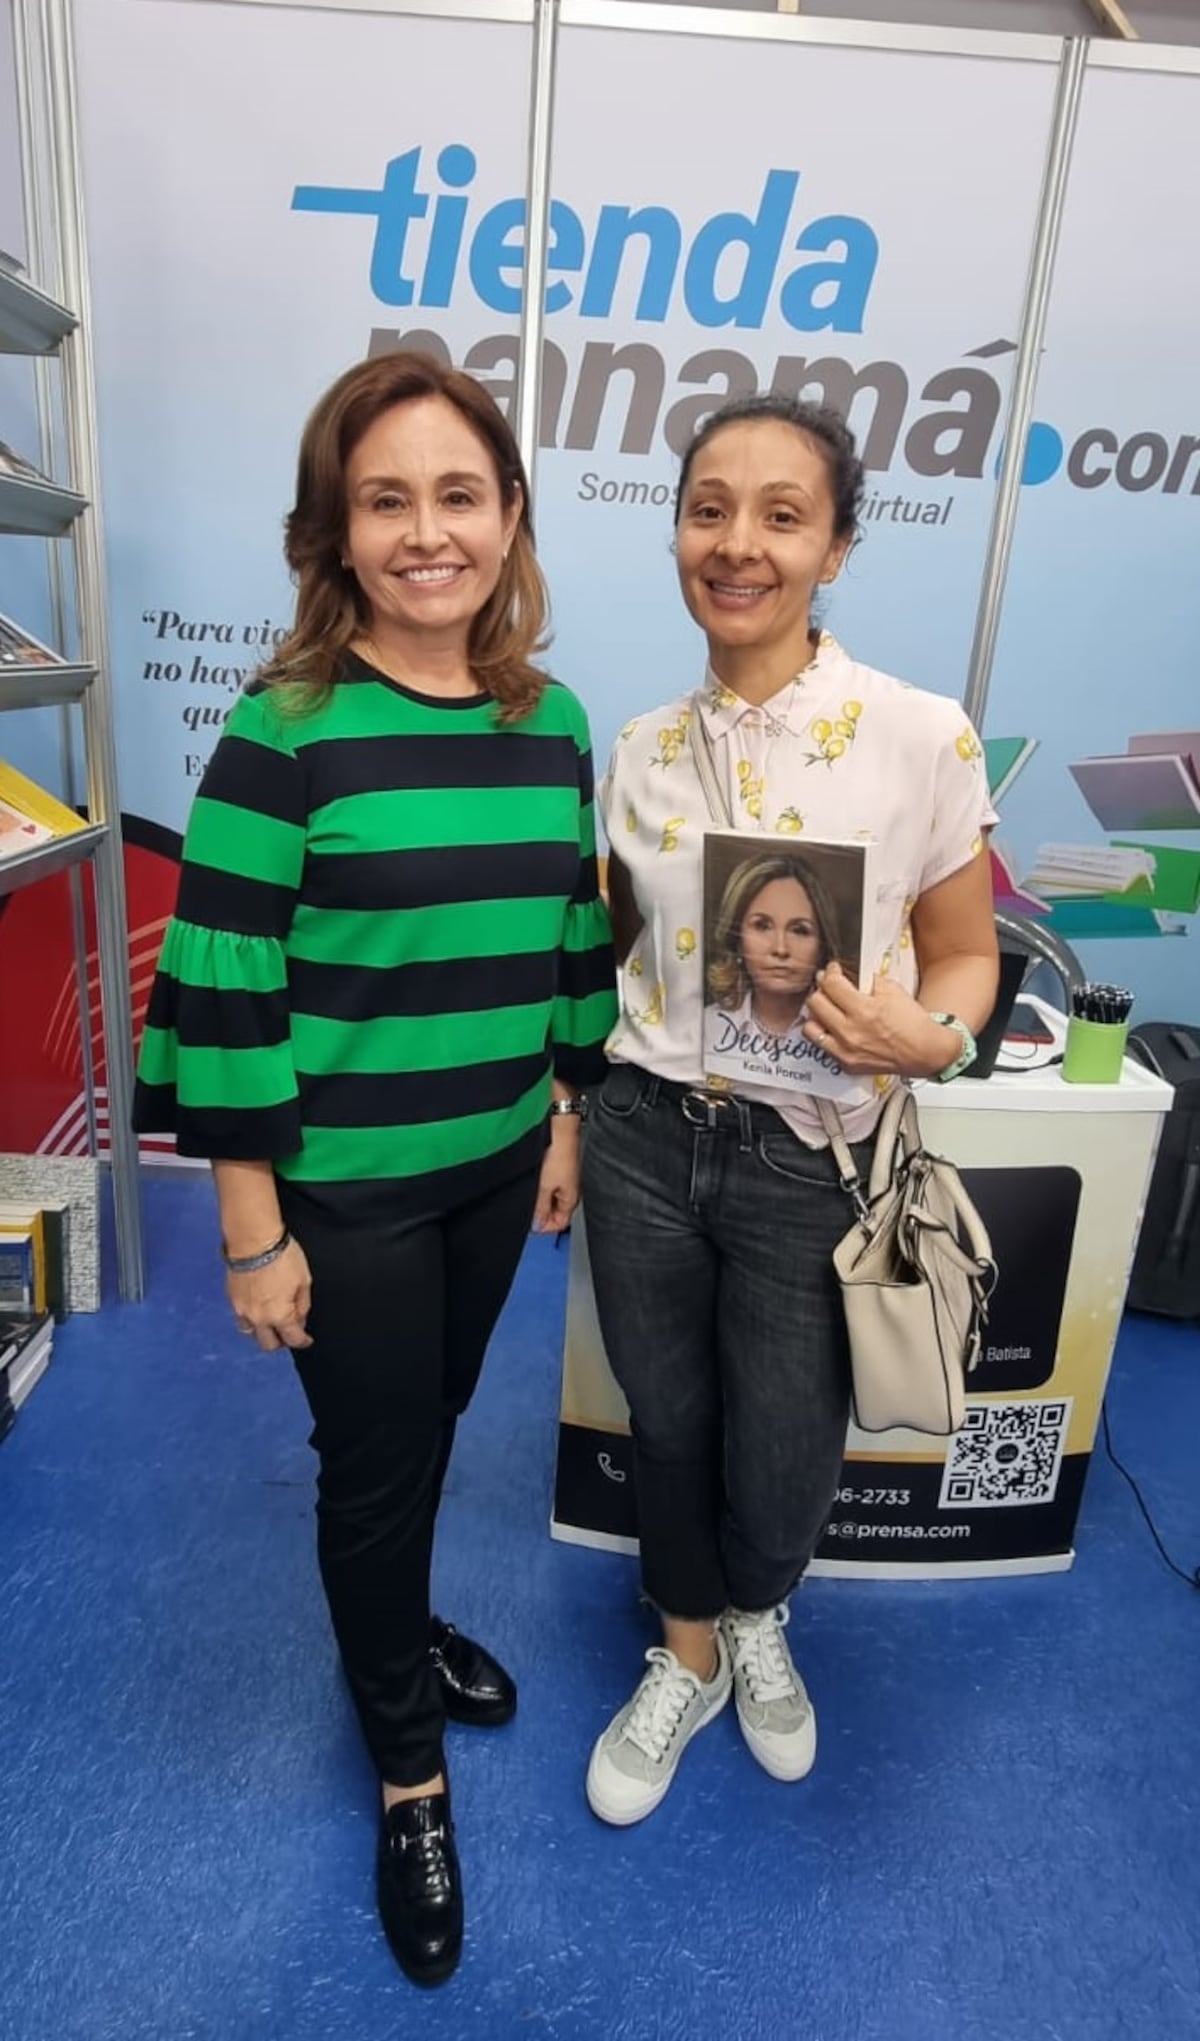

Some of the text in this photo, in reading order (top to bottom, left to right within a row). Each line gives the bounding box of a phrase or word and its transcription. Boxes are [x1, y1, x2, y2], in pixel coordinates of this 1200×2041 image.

[290, 143, 880, 334] tienda
[143, 656, 247, 693] no hay
[713, 1012, 843, 1076] Decisiones
[986, 1346, 1031, 1362] Batista
